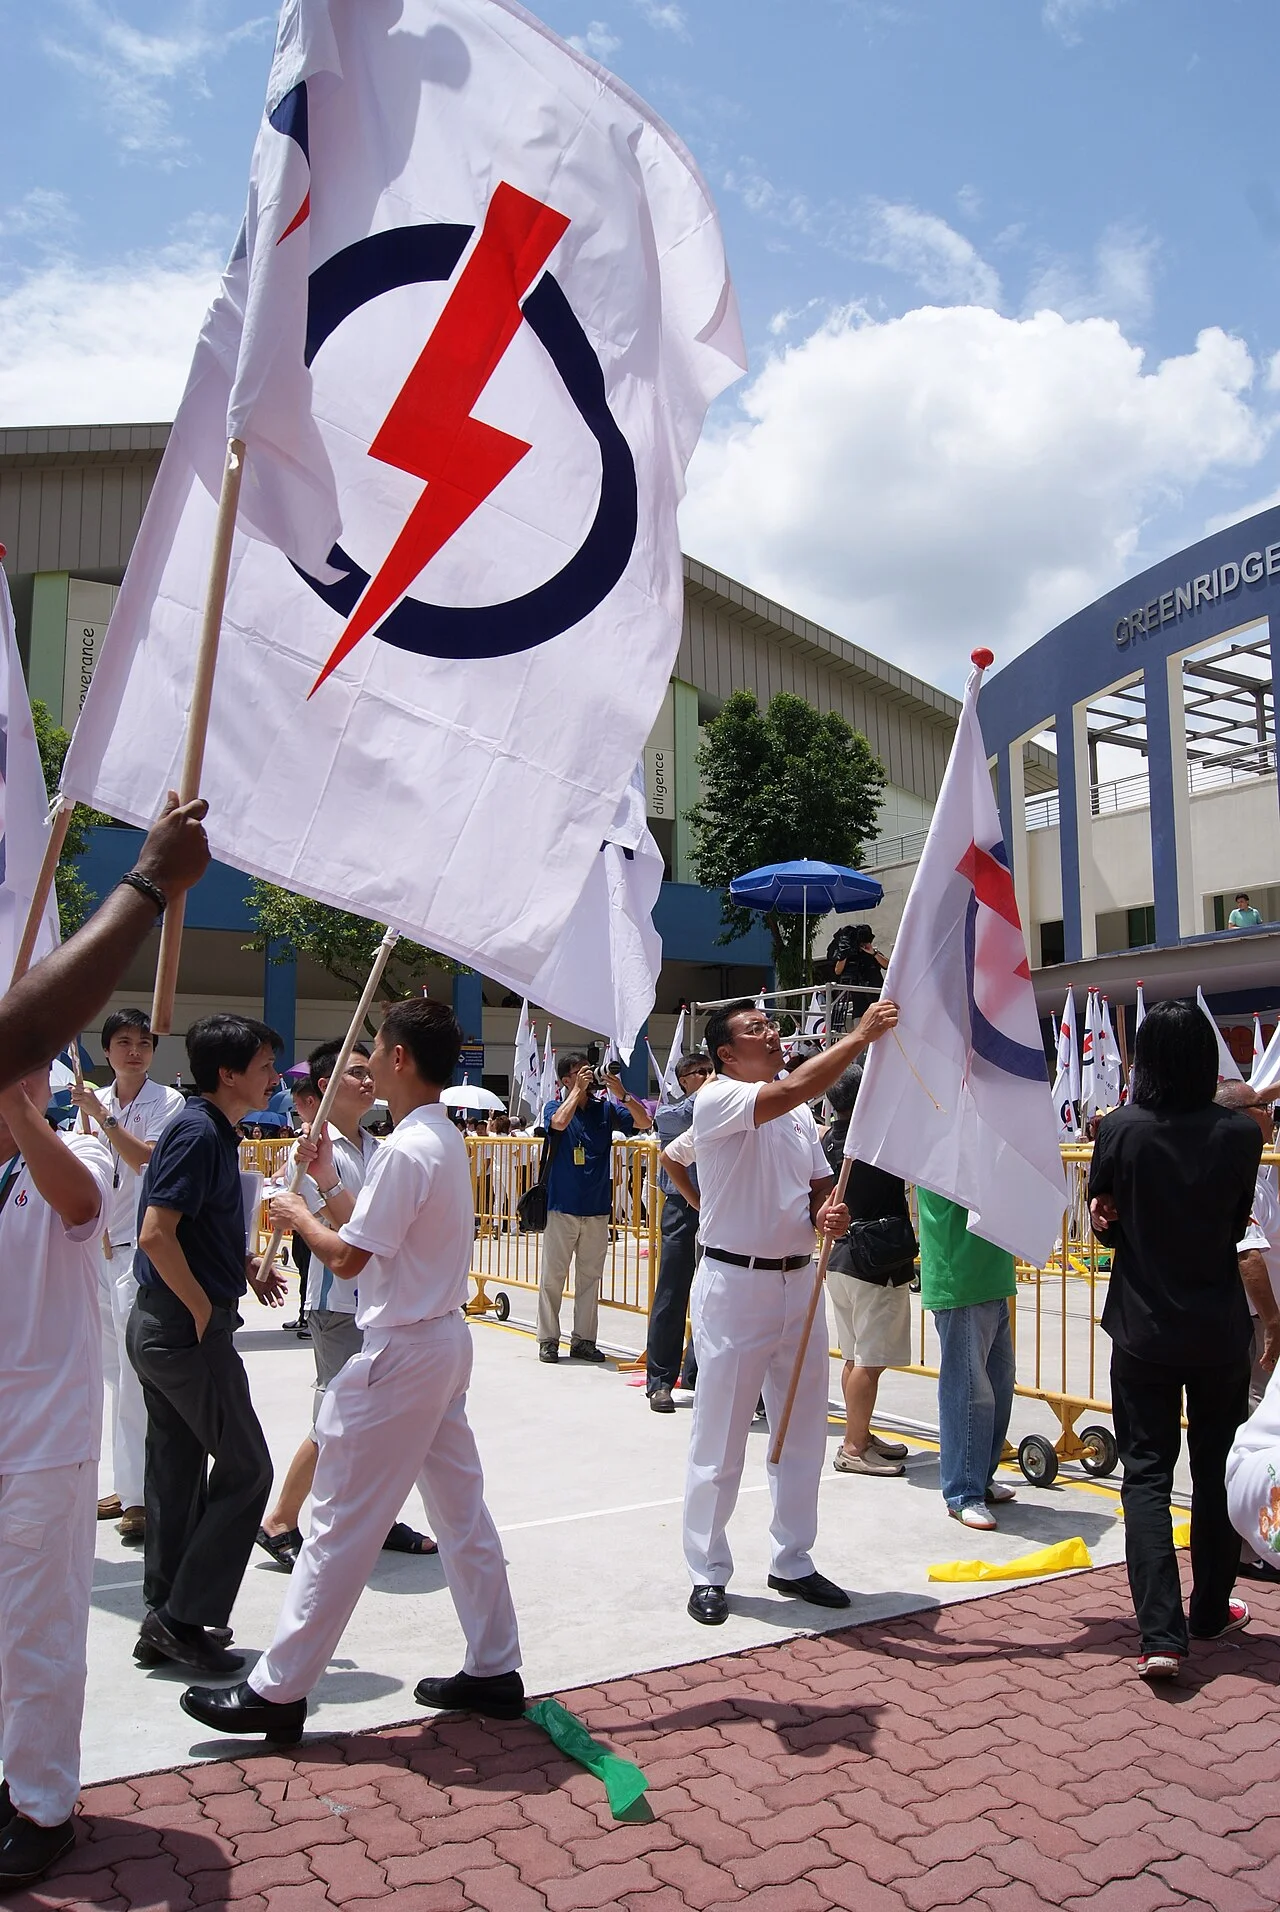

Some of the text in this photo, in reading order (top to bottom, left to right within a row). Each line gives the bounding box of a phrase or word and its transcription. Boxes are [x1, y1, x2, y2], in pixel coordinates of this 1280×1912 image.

[1113, 542, 1280, 646] GREENRIDGE
[79, 627, 95, 714] everance
[652, 752, 667, 815] diligence
